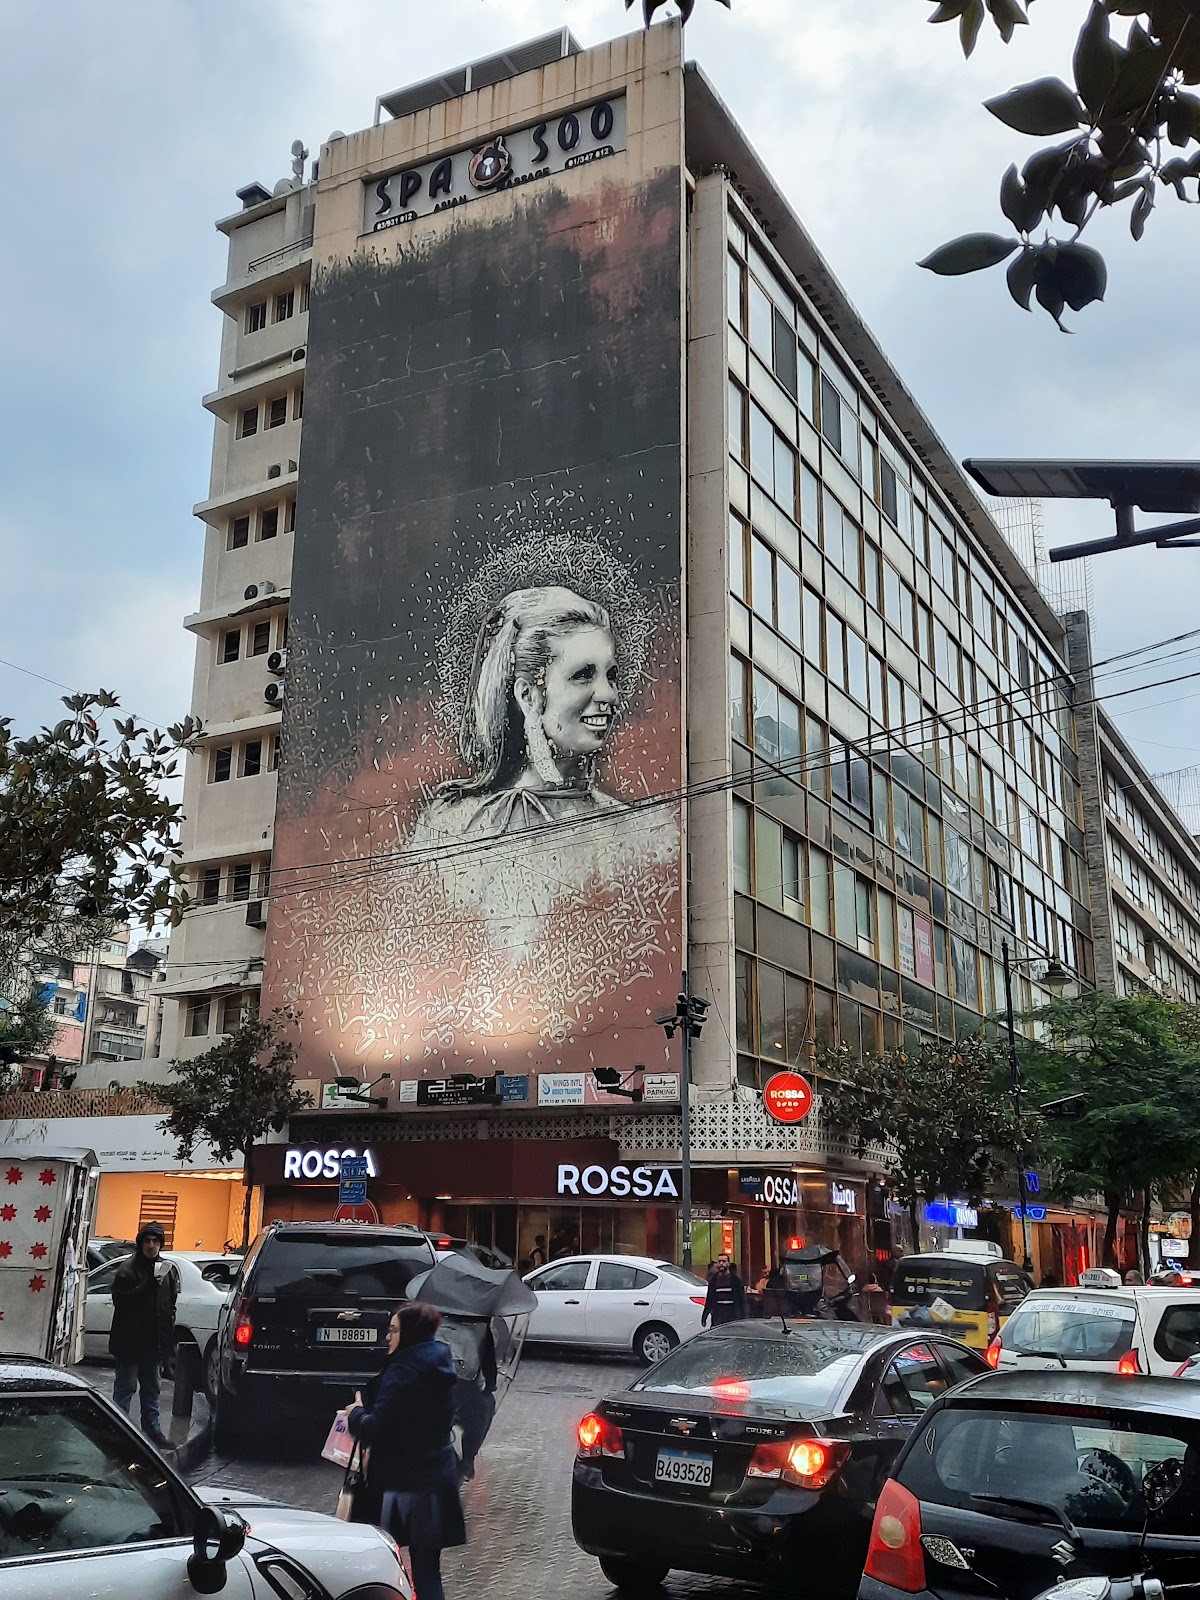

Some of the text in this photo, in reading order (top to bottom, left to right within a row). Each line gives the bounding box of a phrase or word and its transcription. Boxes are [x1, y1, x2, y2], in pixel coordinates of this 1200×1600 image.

[375, 157, 452, 215] SPA
[433, 194, 467, 213] ASIAN
[646, 1078, 676, 1088] موقف
[770, 1090, 805, 1099] ROSSA
[557, 1164, 679, 1197] ROSSA
[324, 1329, 371, 1340] N 188891
[745, 1426, 772, 1436] CRUZE
[656, 1459, 711, 1484] B493528
